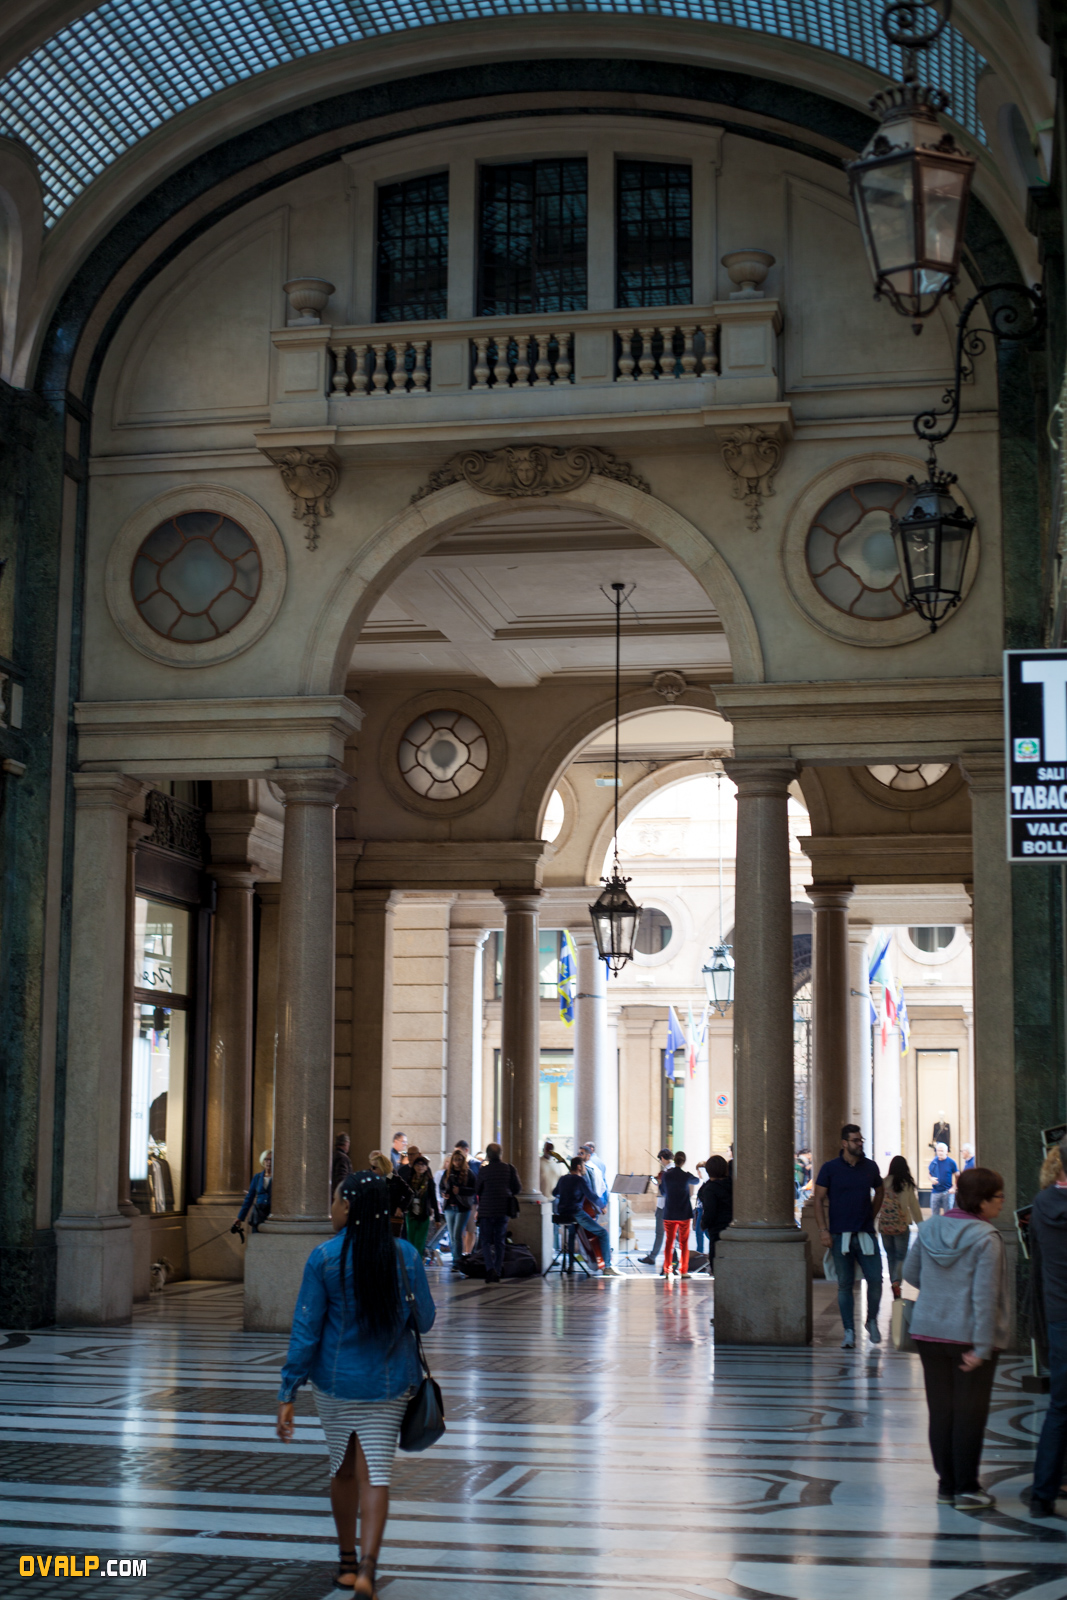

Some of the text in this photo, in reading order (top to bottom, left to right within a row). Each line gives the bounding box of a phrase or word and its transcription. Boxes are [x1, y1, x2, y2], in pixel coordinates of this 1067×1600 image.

[1021, 660, 1067, 762] T
[1037, 767, 1065, 781] SALI
[1022, 840, 1067, 854] BOLL
